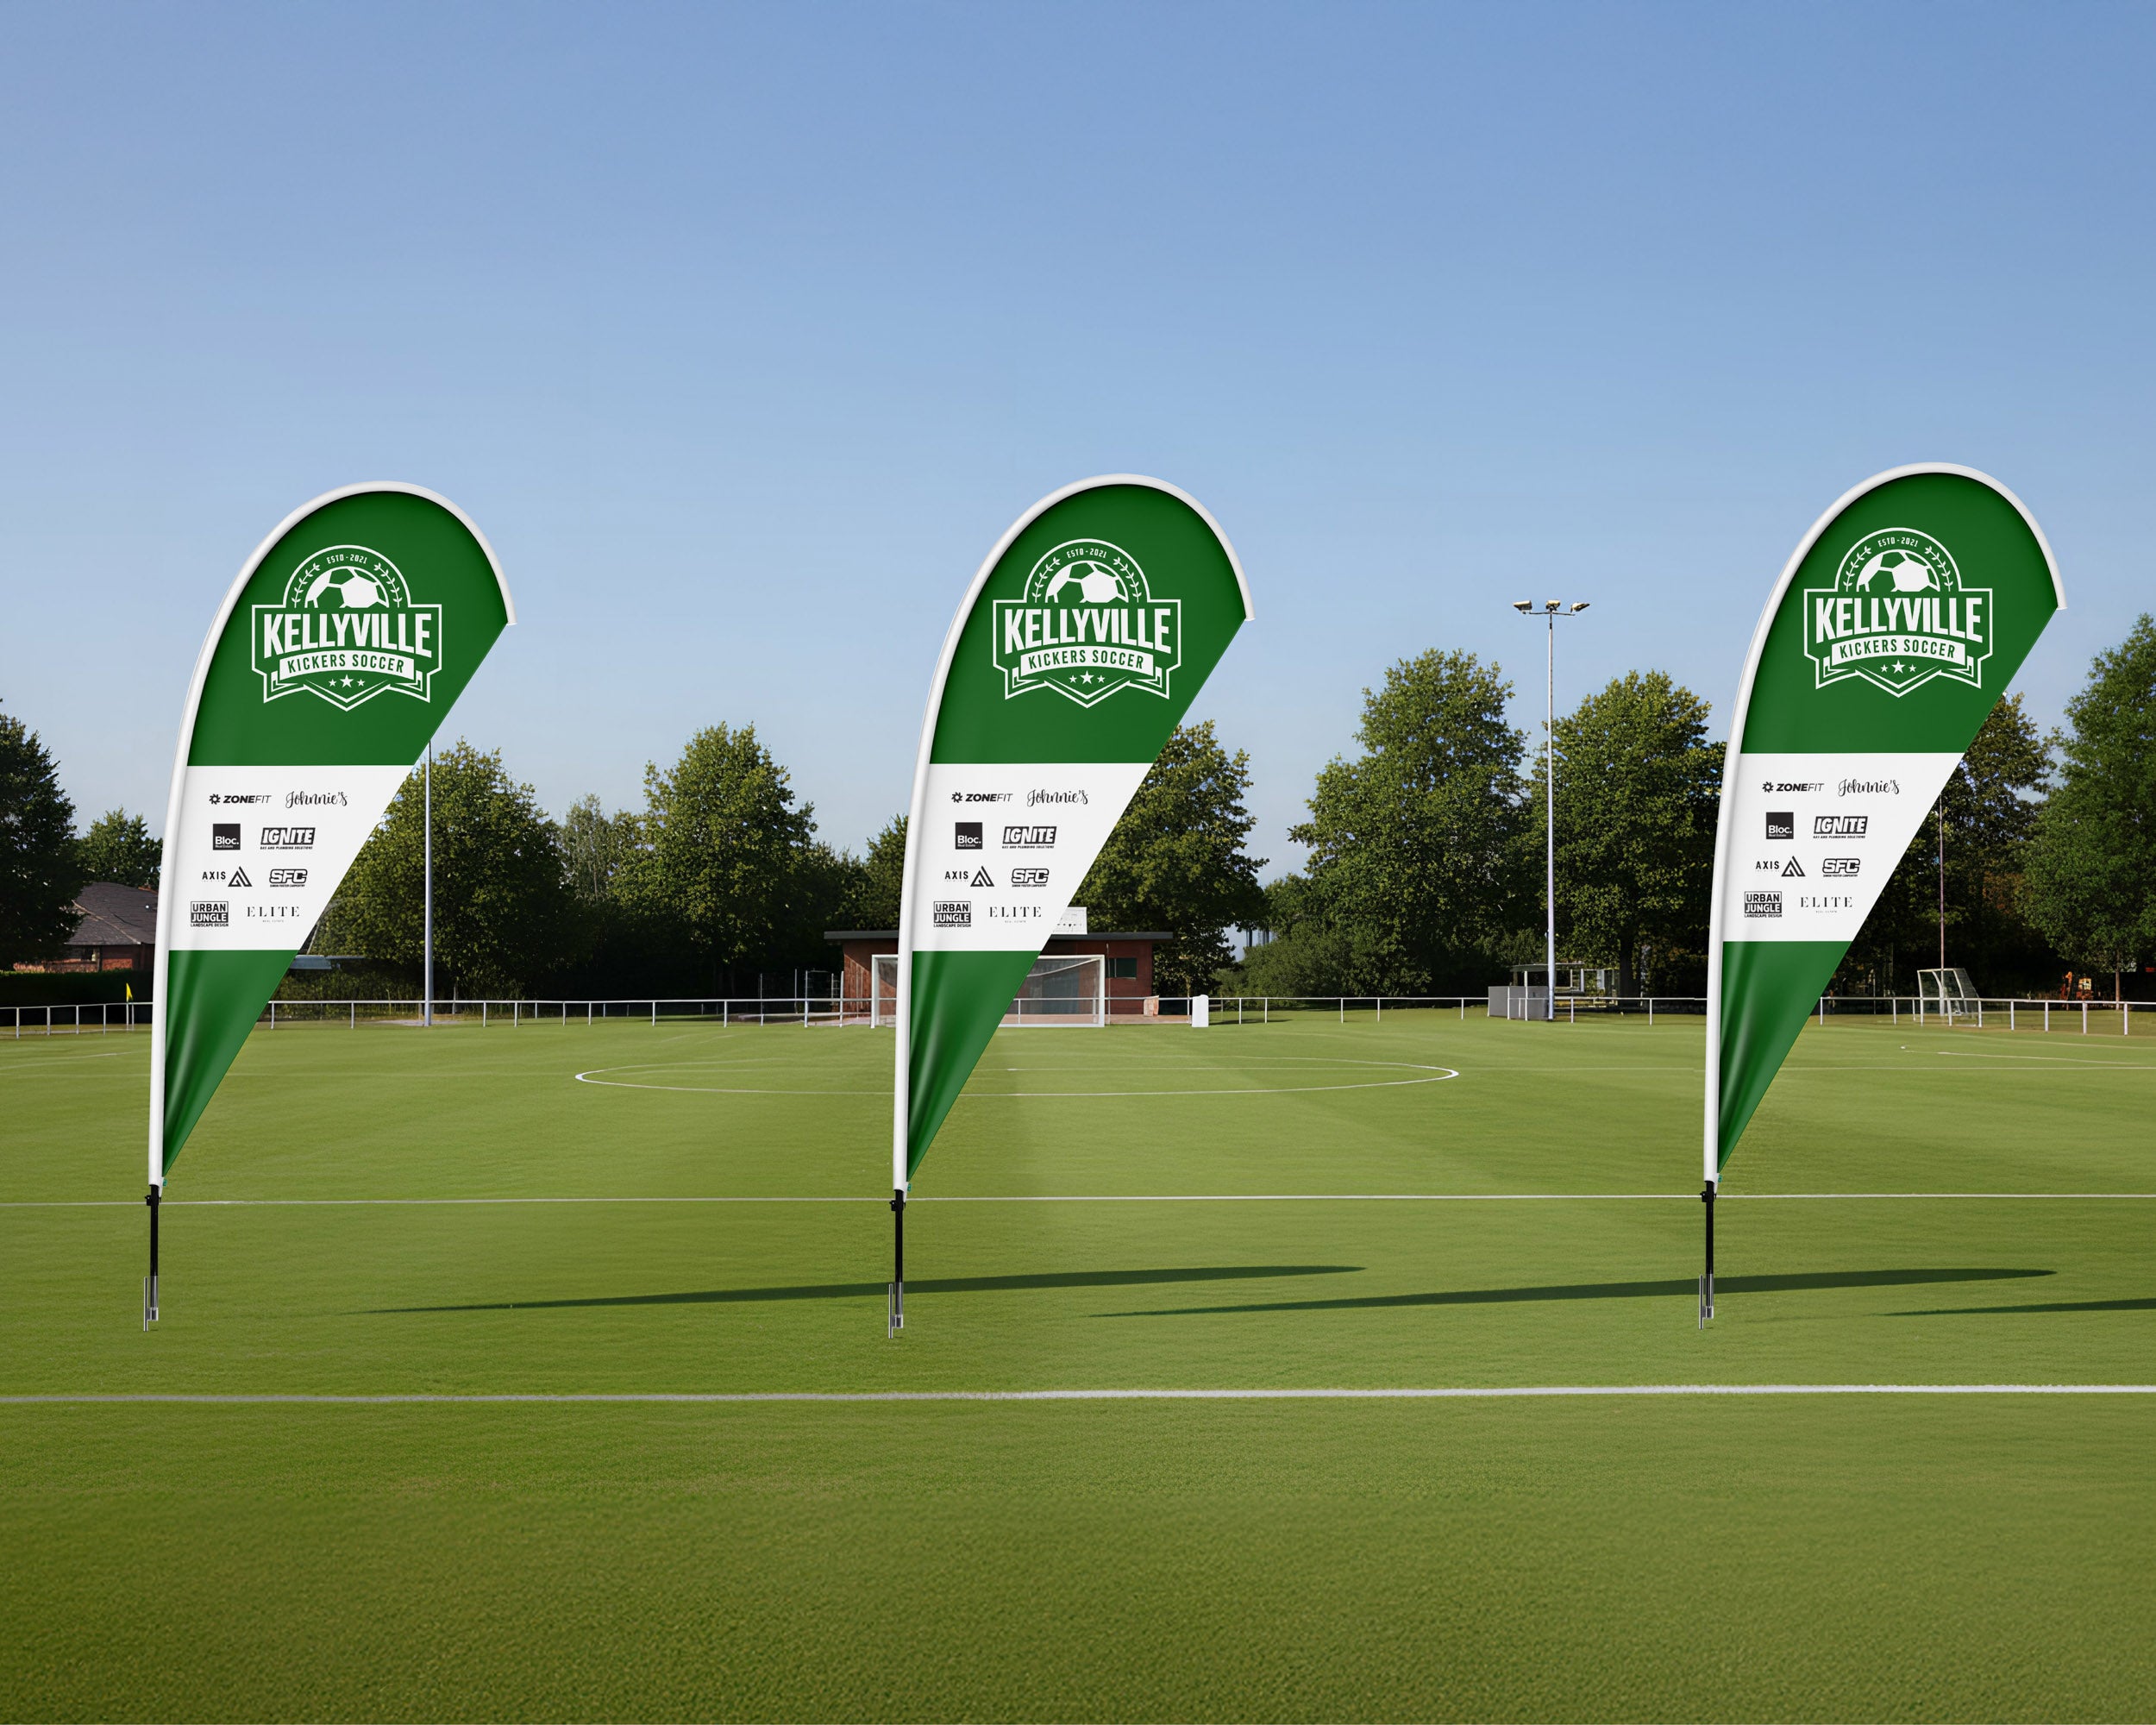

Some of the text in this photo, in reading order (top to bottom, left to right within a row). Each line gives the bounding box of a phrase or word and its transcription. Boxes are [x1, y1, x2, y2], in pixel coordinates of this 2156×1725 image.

[1902, 537, 1919, 548] 2021
[350, 554, 367, 564] 2021
[1090, 549, 1107, 558] 2021
[1816, 598, 1983, 643] KELLYVILLE
[264, 613, 432, 659] KELLYVILLE
[1005, 608, 1171, 655] KELLYVILLE
[1839, 639, 1955, 658] KICKERS SOCCER
[288, 654, 404, 674] KICKERS SOCCER
[1028, 649, 1144, 669] KICKERS SOCCER
[1776, 783, 1824, 792] ZONEFIT
[1839, 779, 1901, 797] Johnnie's
[223, 795, 272, 804] ZONEFIT
[285, 791, 348, 809] Johnnie's
[965, 794, 1013, 802] ZONEFIT
[1026, 789, 1089, 807] Johnnie's
[1768, 825, 1792, 834] Bloc.
[1815, 818, 1866, 832] IGNITE
[262, 828, 314, 844] IGNITE
[957, 835, 981, 844] Bloc.
[1004, 827, 1056, 843] IGNITE
[216, 837, 239, 845] Bloc.
[1756, 861, 1779, 869] AXIS
[1823, 859, 1859, 873] SFC
[202, 871, 226, 880] AXIS
[270, 869, 307, 883] SFC
[945, 870, 968, 879] AXIS
[1012, 869, 1048, 882] SFC
[1746, 894, 1779, 902] URBAN
[1801, 897, 1852, 907] ELITE
[193, 903, 226, 912] URBAN
[247, 906, 300, 917] ELITE
[936, 903, 968, 912] URBAN
[989, 906, 1042, 917] ELITE
[1745, 904, 1780, 913] JUNGLE
[192, 913, 227, 922] JUNGLE
